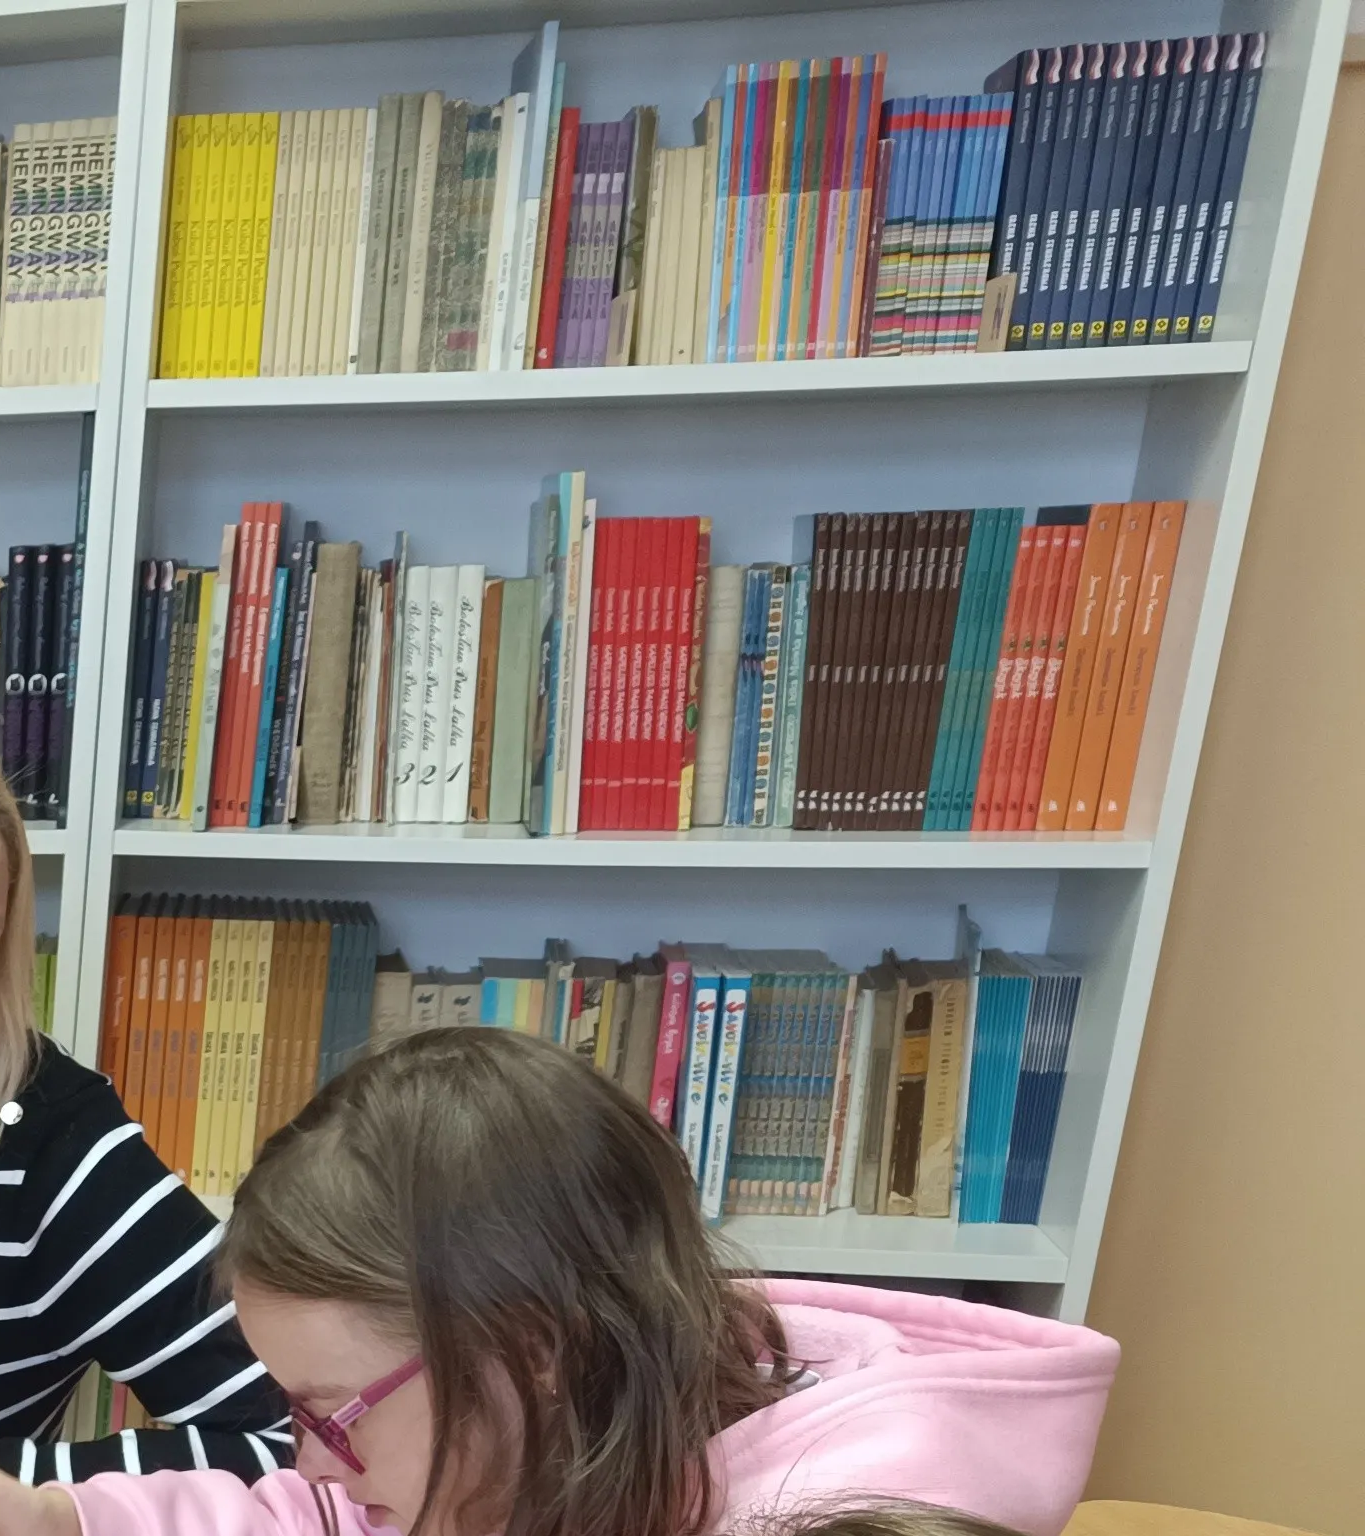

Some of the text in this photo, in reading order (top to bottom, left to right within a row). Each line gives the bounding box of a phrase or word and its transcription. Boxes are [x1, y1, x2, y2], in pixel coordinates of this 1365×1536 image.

[6, 148, 29, 279] HEMINGWAY
[26, 146, 49, 278] HEMINGWAY
[44, 145, 68, 277] HEMINGWAY
[63, 143, 86, 276] HEMINGWAY
[80, 142, 104, 274] HEMINGWAY
[452, 666, 469, 700] Prus
[393, 761, 415, 787] 3
[417, 763, 437, 786] 2
